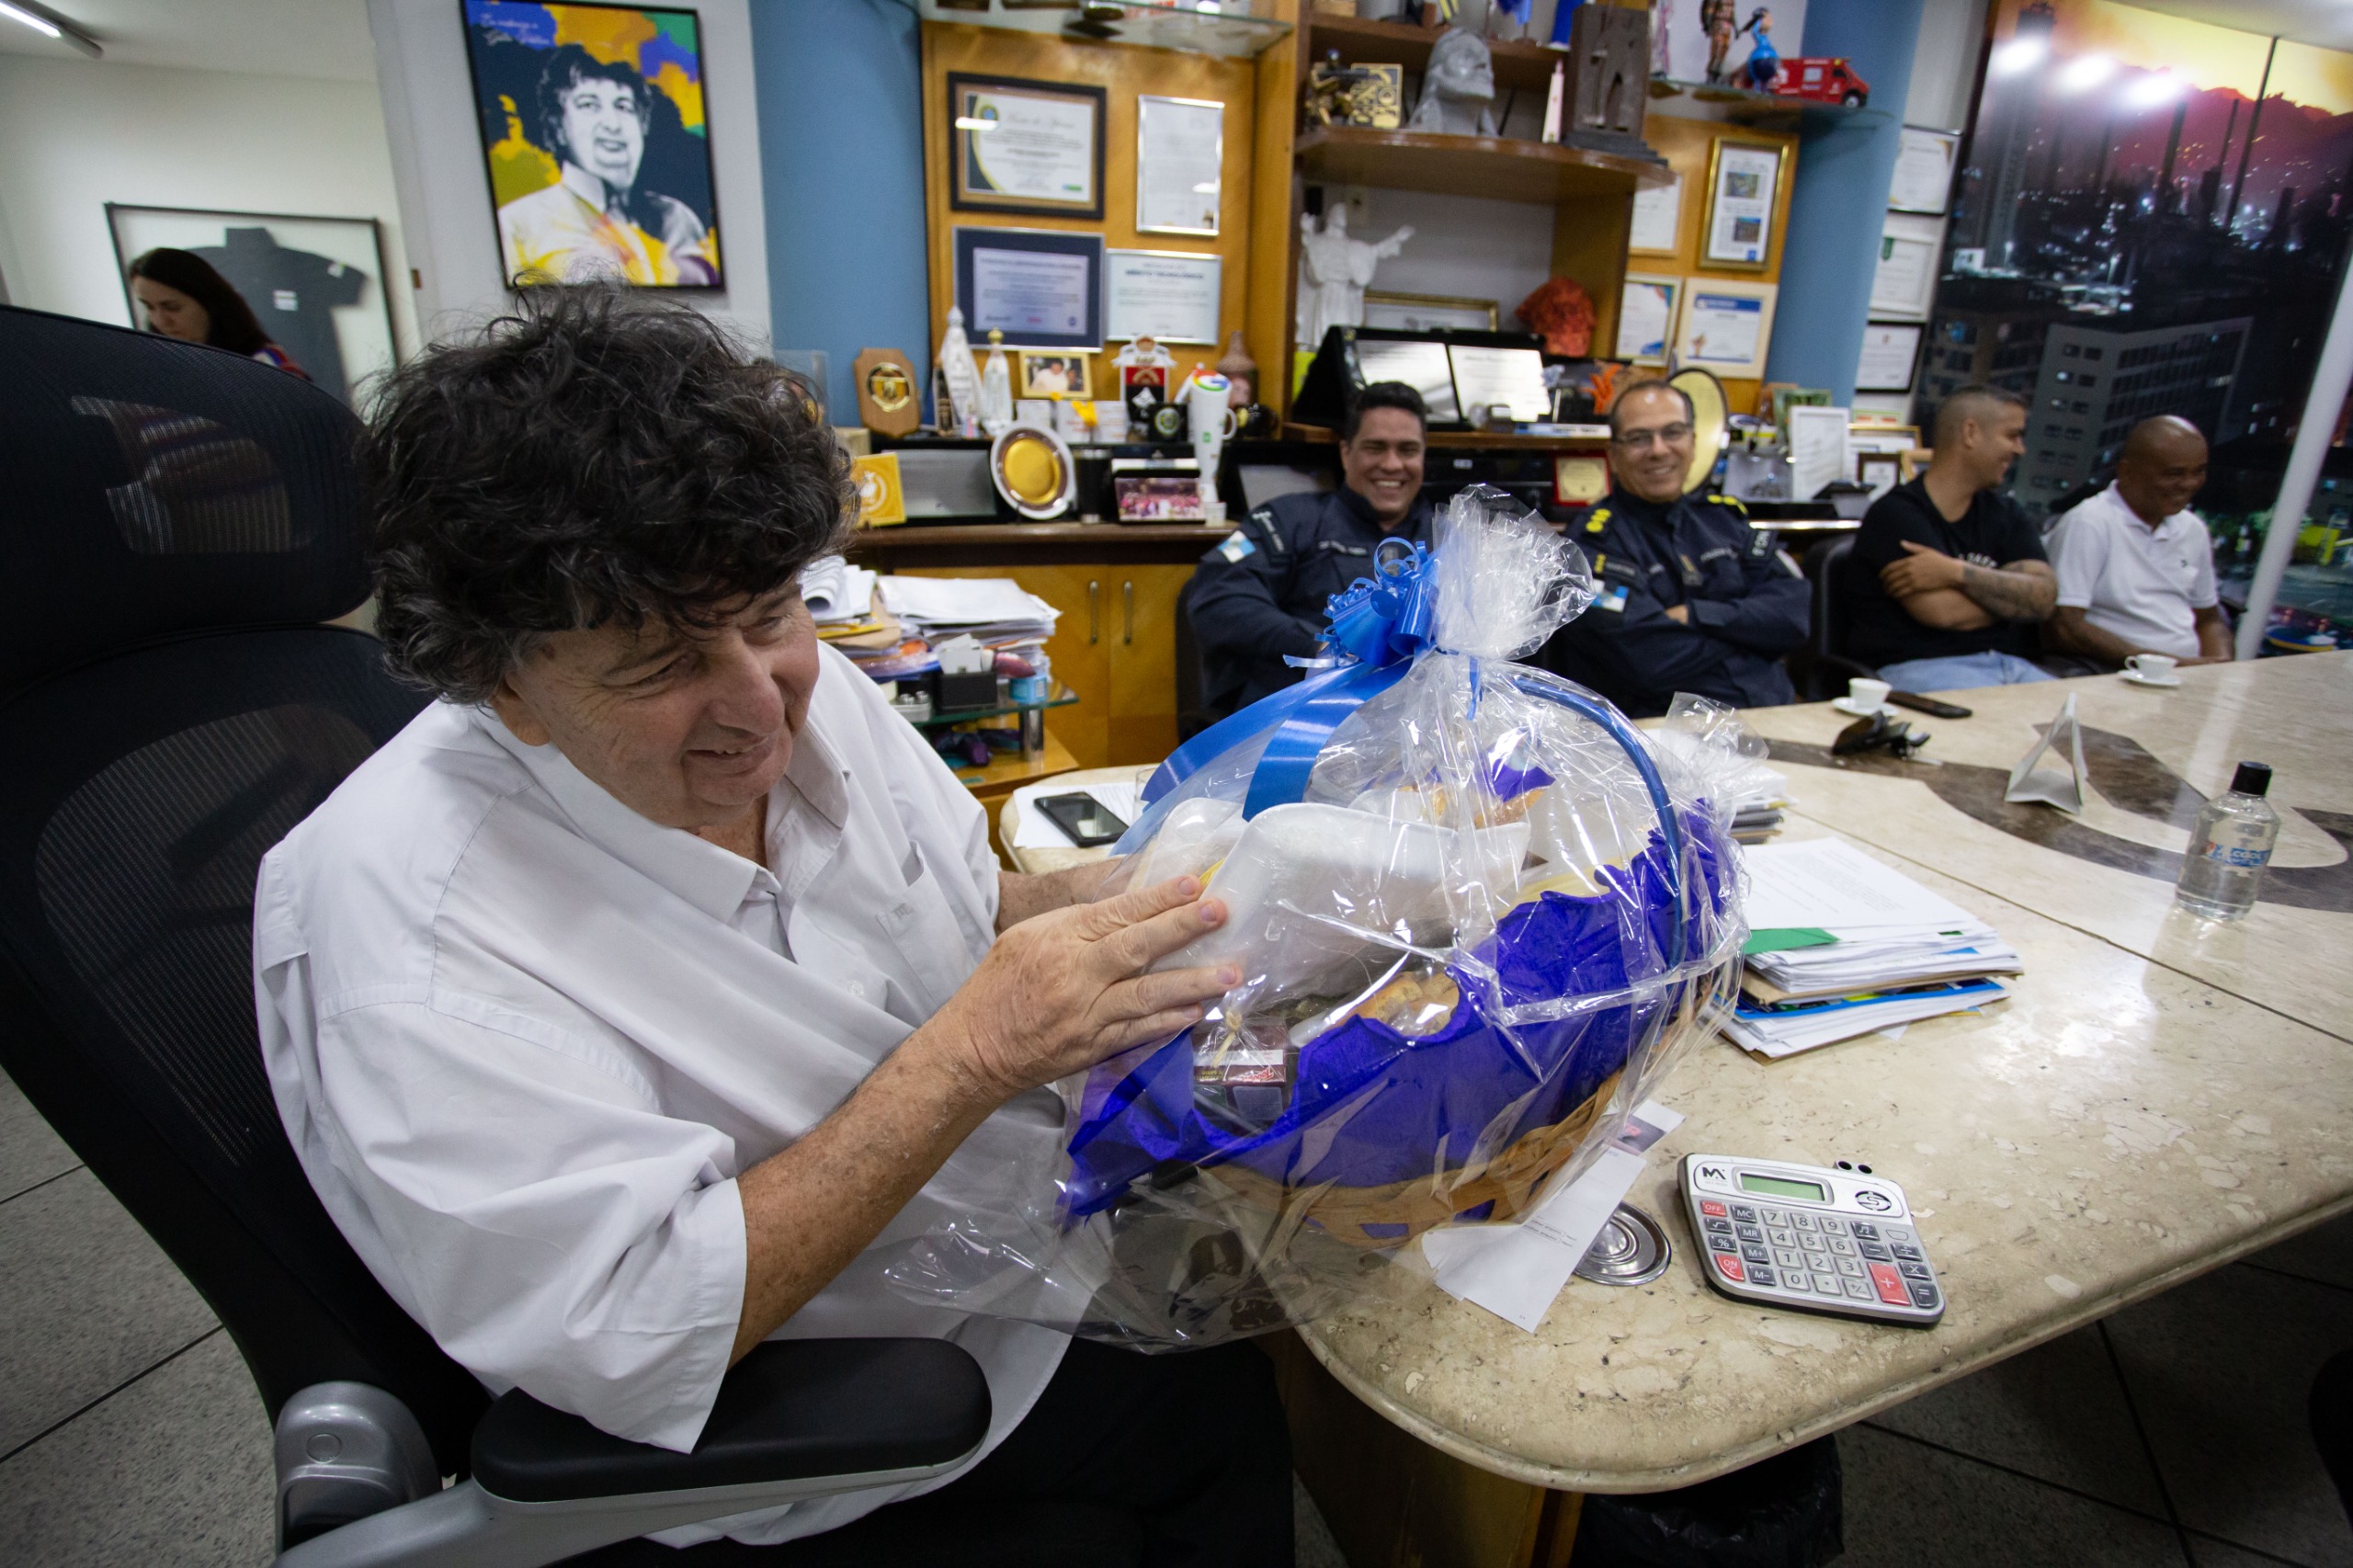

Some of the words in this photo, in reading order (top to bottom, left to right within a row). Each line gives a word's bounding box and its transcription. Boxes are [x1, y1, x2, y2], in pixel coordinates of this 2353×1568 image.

[1737, 1210, 1753, 1218] MC
[1769, 1212, 1777, 1221] 7
[1800, 1217, 1808, 1226] 8
[1828, 1221, 1837, 1230] 9
[1743, 1229, 1757, 1237] MR
[1777, 1233, 1786, 1242] 4
[1718, 1239, 1729, 1248] %
[1806, 1237, 1815, 1245] 5
[1836, 1242, 1846, 1250] 6
[1748, 1249, 1763, 1257] M+
[1723, 1259, 1738, 1267] ON
[1784, 1254, 1790, 1263] 1
[1814, 1257, 1824, 1267] 2
[1845, 1262, 1854, 1271] 3
[1790, 1275, 1801, 1284] 0
